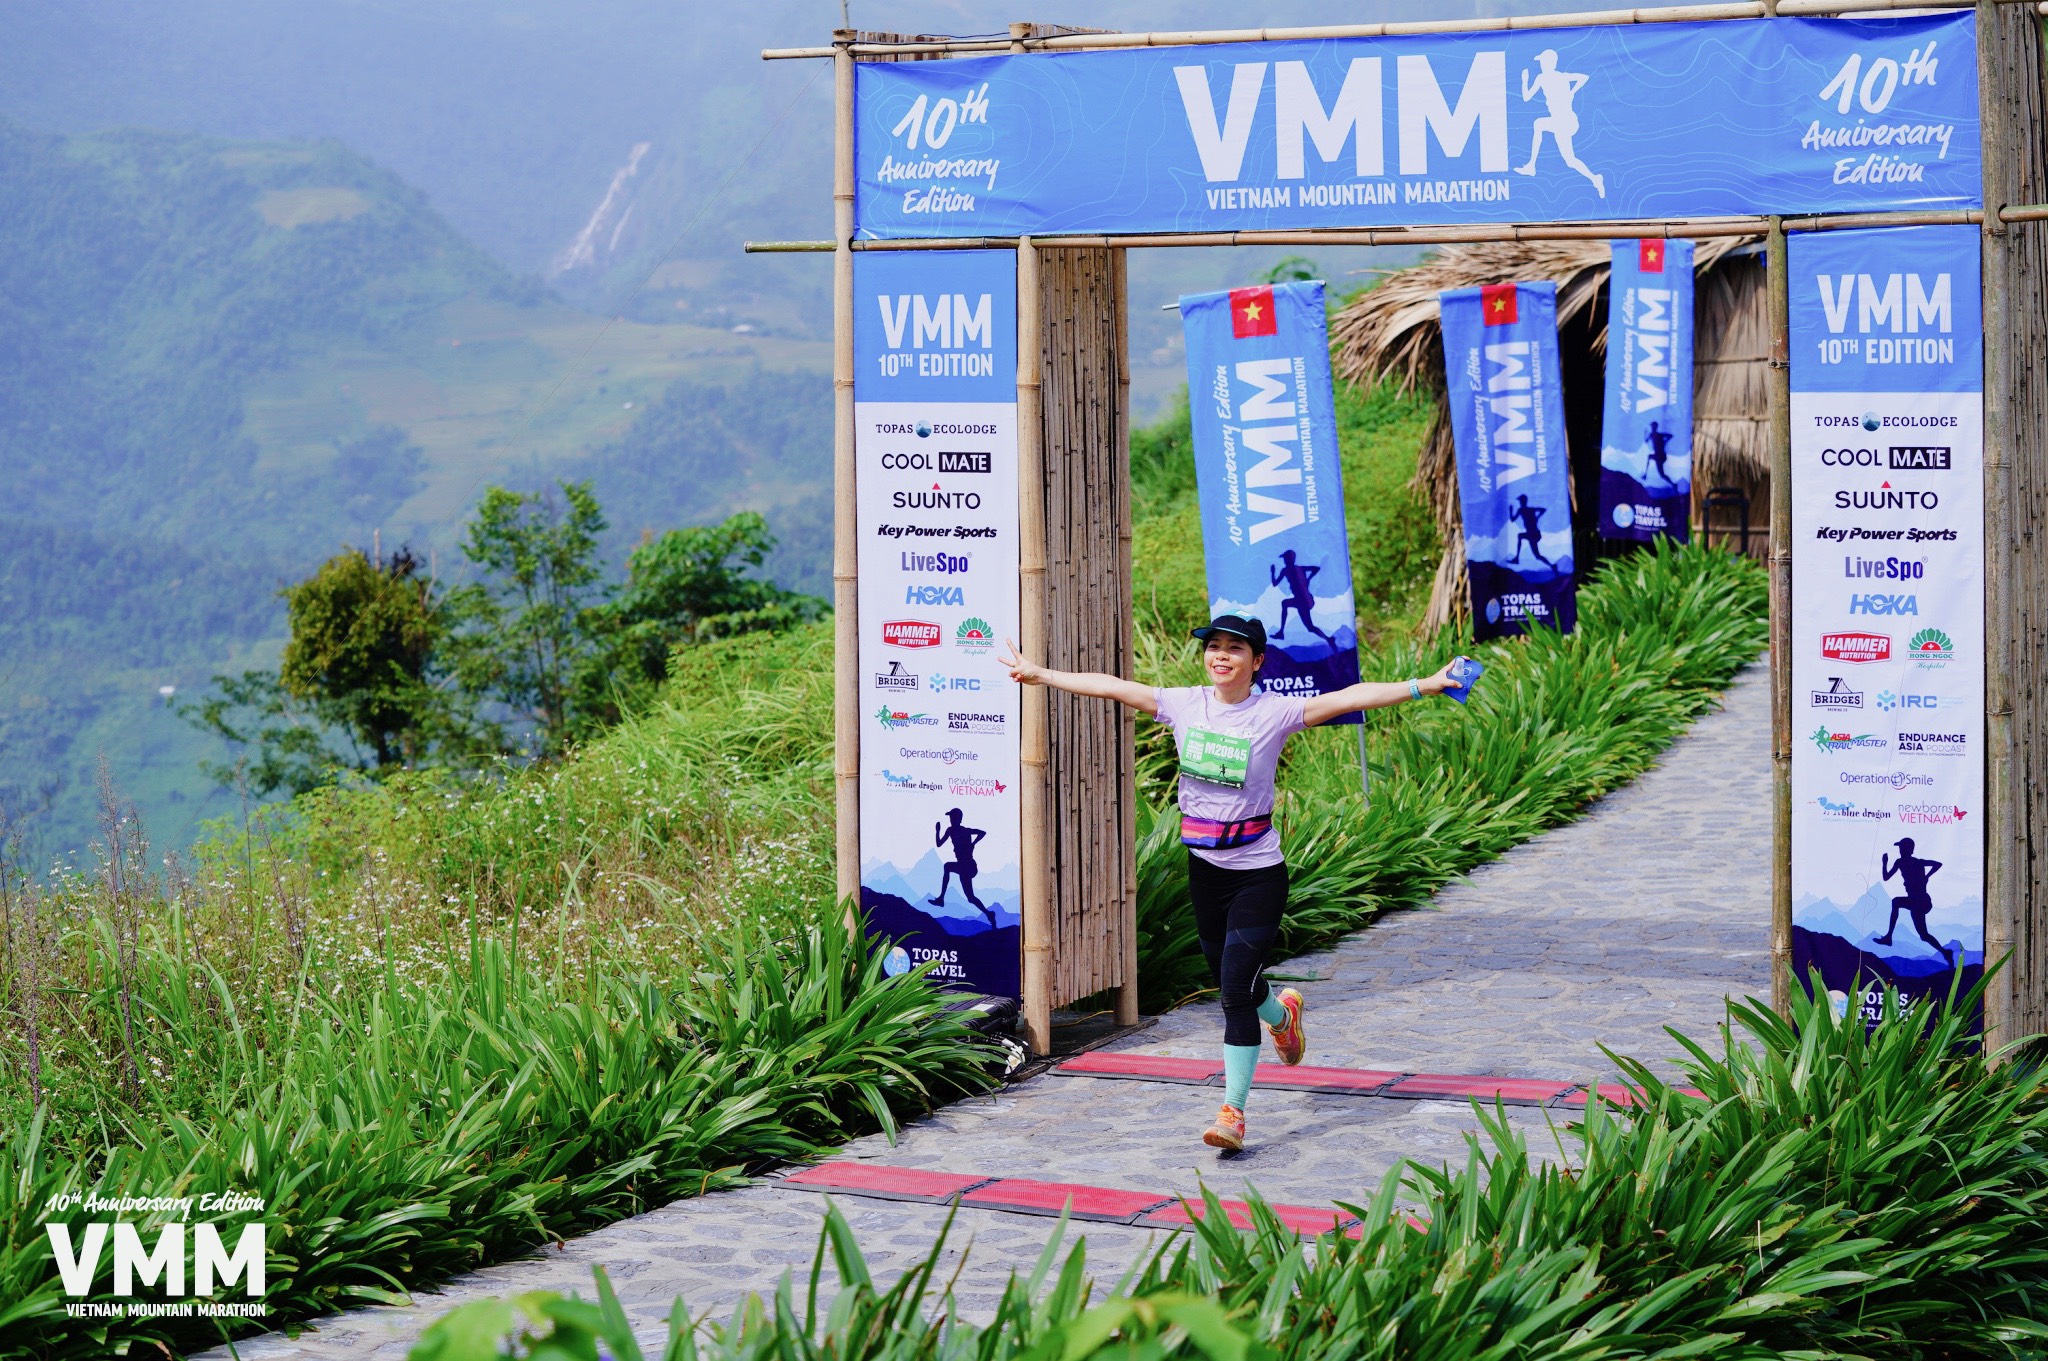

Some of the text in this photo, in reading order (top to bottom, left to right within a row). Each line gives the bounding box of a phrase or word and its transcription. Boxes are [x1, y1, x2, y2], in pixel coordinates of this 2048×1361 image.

[1819, 40, 1938, 115] 10th
[892, 82, 989, 150] 10th
[1172, 51, 1510, 182] VMM
[1801, 119, 1954, 159] Anniversary
[877, 154, 999, 190] Anniversary
[1832, 153, 1924, 185] Edition
[902, 185, 975, 214] Edition
[1205, 179, 1510, 210] VIETNAM MOUNTAIN MARATHON
[1817, 273, 1952, 334] VMM
[877, 293, 992, 349] VMM
[1636, 287, 1671, 414] VMM
[1818, 338, 1953, 364] 10TH EDITION
[878, 353, 993, 377] 10TH EDITION
[1466, 347, 1482, 391] Edition
[1531, 341, 1548, 474] VIETNAM MOUNTAIN MARATHON
[1485, 341, 1537, 490] VMM
[1814, 416, 1958, 427] TOPAS ECOLODGE
[876, 424, 997, 435] TOPAS ECOLODGE
[1474, 395, 1491, 468] Anniversary
[1293, 357, 1320, 523] VIETNAM MOUNTAIN MARATHON
[1213, 364, 1243, 547] 10th Anniversary Edition
[1235, 357, 1306, 545] VMM
[1821, 448, 1946, 467] COOL MATE
[881, 453, 987, 471] COOL MATE
[893, 491, 981, 509] SUUNTO
[1835, 490, 1939, 510] SUUNTO
[878, 524, 997, 539] Key Power Sports
[1816, 527, 1957, 542] Key Power Sports
[905, 585, 964, 606] HOKA
[1501, 593, 1541, 605] TOPAS
[1502, 604, 1549, 616] TRAVEL
[1850, 594, 1918, 616] HOKA
[885, 624, 939, 639] HAMMER
[897, 638, 930, 646] NUTRITION
[1824, 637, 1889, 653] HAMMER
[1839, 652, 1877, 660] NUTRITION
[888, 661, 898, 676] 7
[878, 675, 916, 687] BRIDGES
[950, 678, 981, 691] IRC
[1263, 675, 1314, 691] TOPAS
[1828, 677, 1840, 693] 7
[1814, 694, 1860, 705] BRIDGES
[1901, 695, 1937, 708] IRC
[891, 711, 910, 719] ASIA
[908, 717, 939, 726] MASTER
[948, 712, 1005, 723] ENDURANCE
[948, 721, 1005, 731] ASIA PODCAST
[1827, 739, 1887, 750] TRAIL MASTER
[1830, 733, 1851, 741] ASIA
[1898, 733, 1966, 743] ENDURANCE
[900, 747, 978, 761] Operation Smile
[1204, 742, 1247, 761] M20845
[1898, 742, 1966, 752] ASIA PODCAST
[902, 779, 917, 789] blue
[918, 780, 943, 792] dragon
[948, 775, 995, 787] newborns
[1840, 771, 1933, 785] Operation Smile
[949, 785, 995, 797] VIETNAM
[1841, 807, 1860, 817] blue
[1862, 808, 1891, 822] dragon
[1898, 801, 1953, 813] newborns
[1898, 812, 1953, 824] VIETNAM
[912, 947, 958, 963] TOPAS
[913, 962, 966, 977] TAVEL
